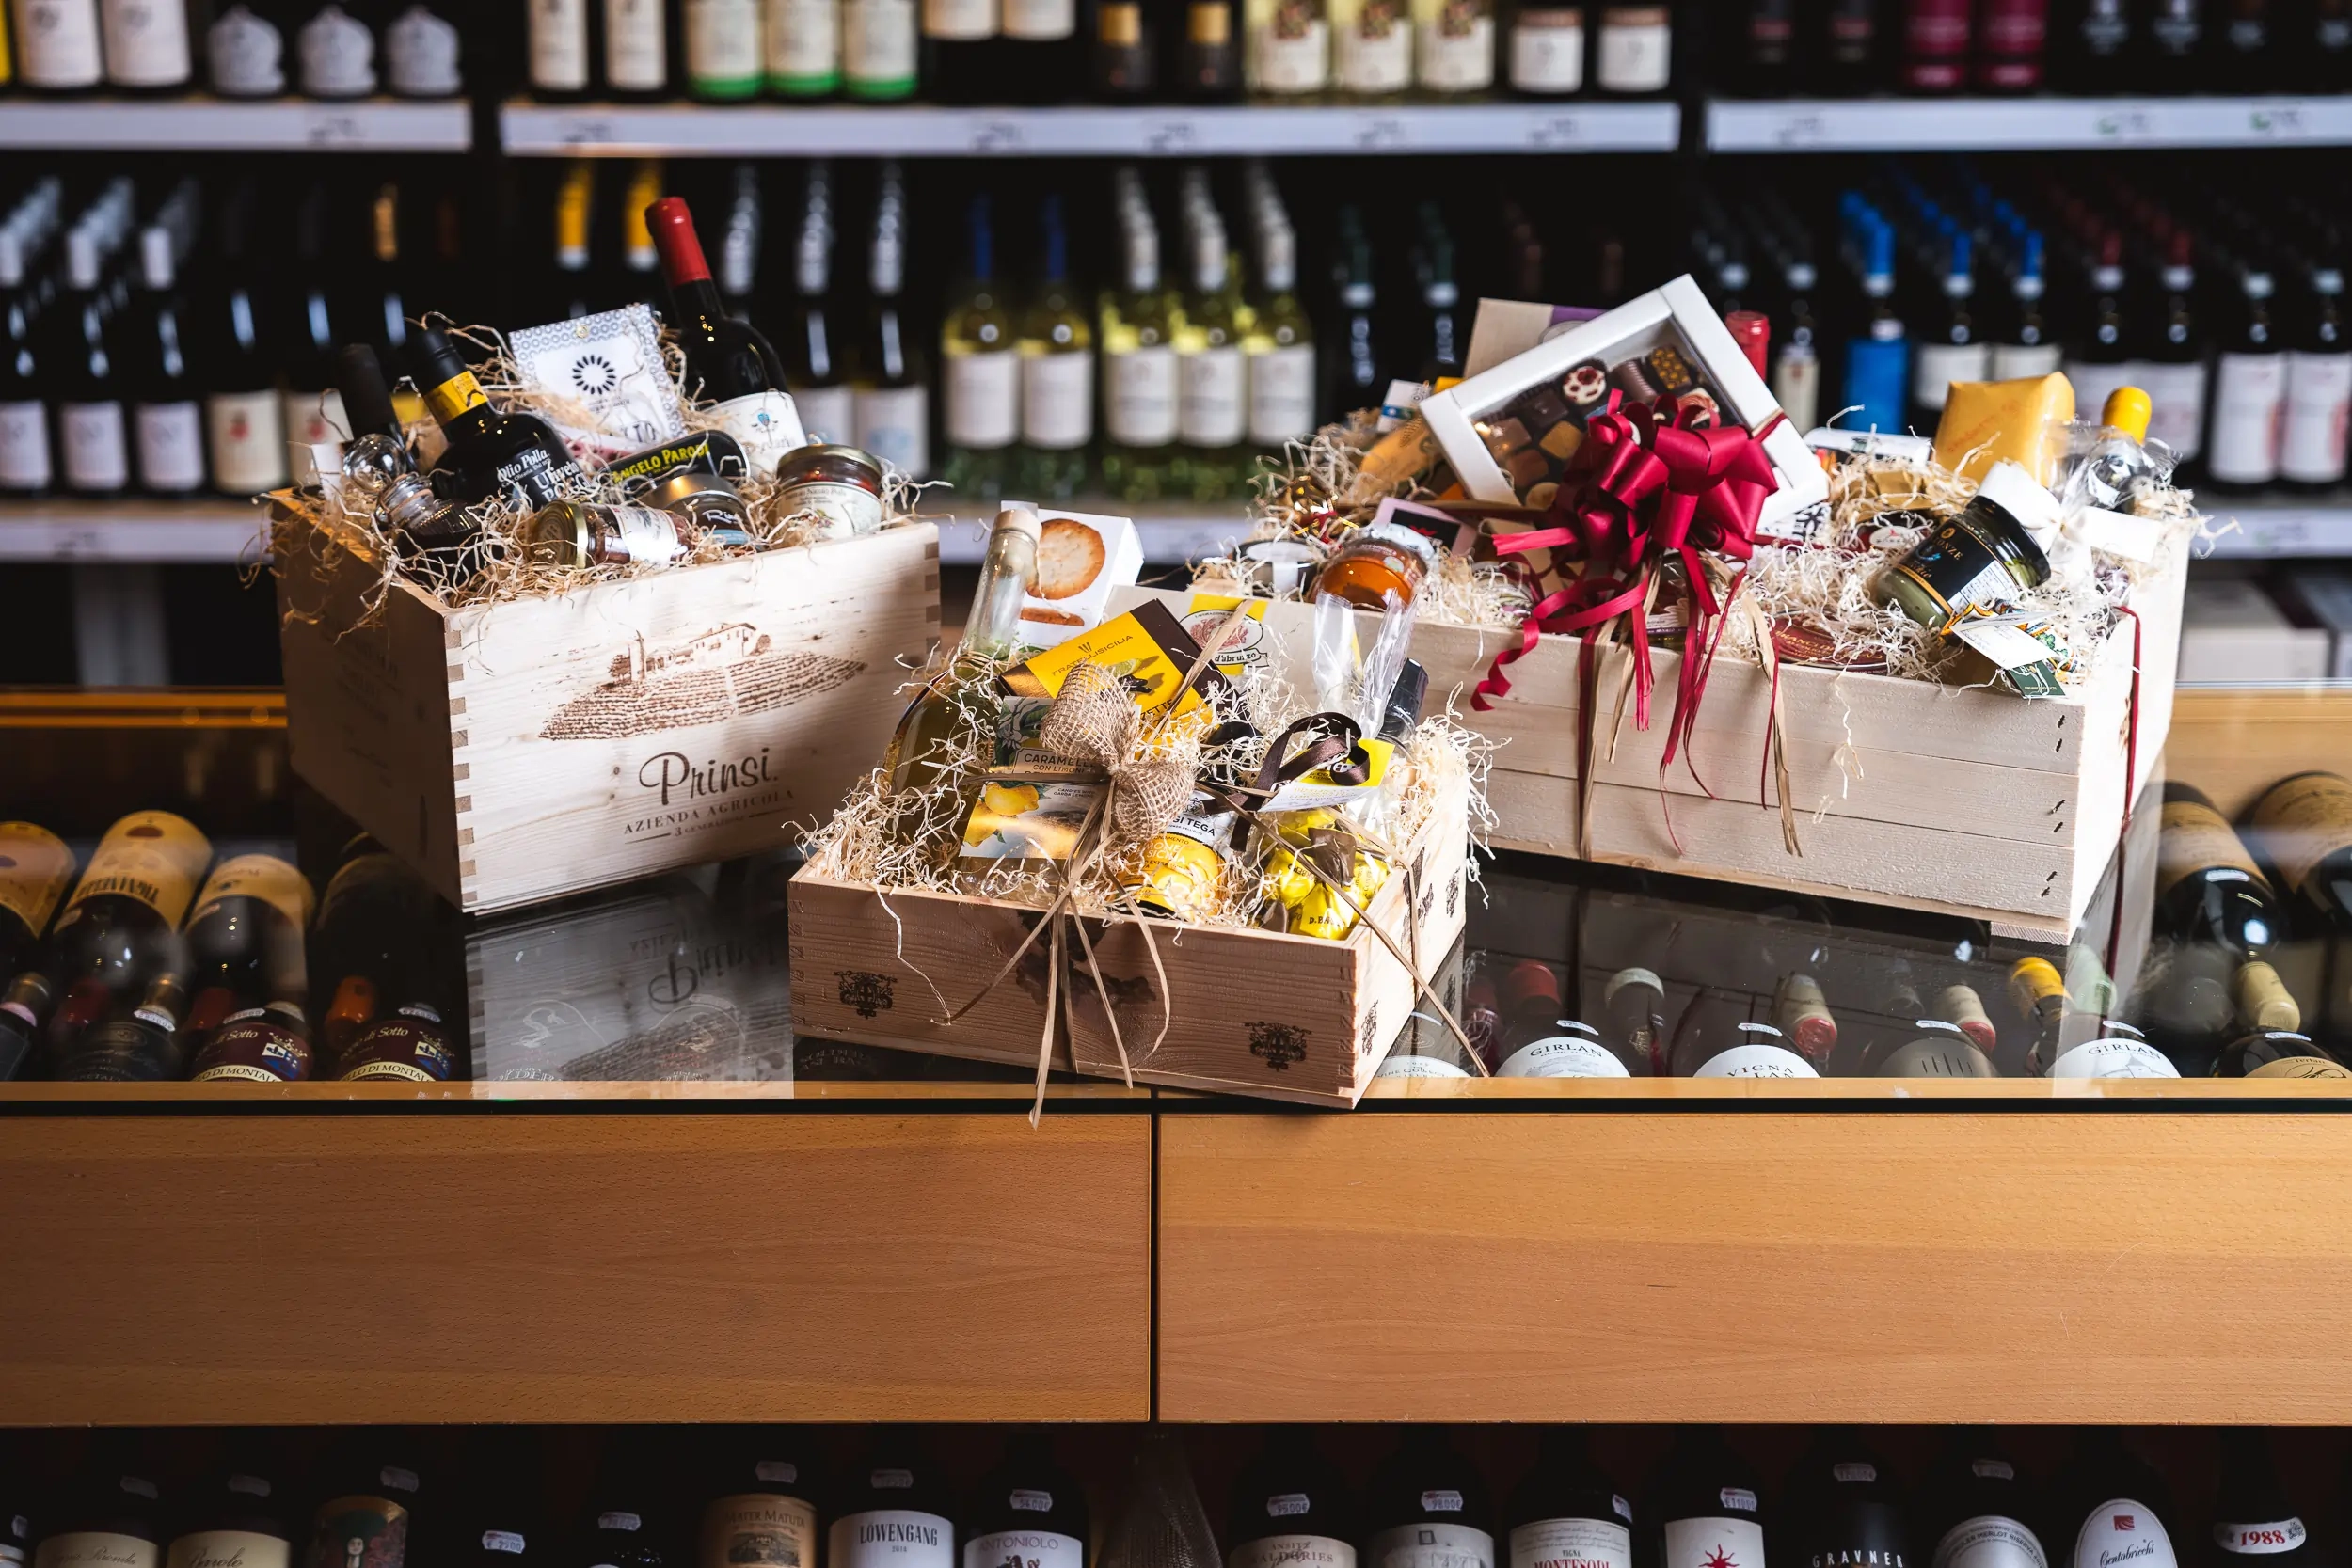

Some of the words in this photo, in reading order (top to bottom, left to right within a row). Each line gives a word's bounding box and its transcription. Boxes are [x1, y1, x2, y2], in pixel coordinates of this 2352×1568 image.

[520, 449, 548, 469] Polla
[612, 455, 660, 485] ANGELO
[624, 809, 700, 835] AZIENDA
[707, 789, 796, 816] AGRICOLA
[675, 826, 683, 837] 3
[1187, 817, 1216, 837] TEGA
[227, 1029, 259, 1040] Sotto
[377, 1026, 410, 1037] Sotto
[1530, 1043, 1602, 1058] GIRLAN
[2088, 1043, 2162, 1060] GIRLAN
[1726, 1064, 1795, 1078] VIGNA
[764, 1509, 805, 1528] MATUTA
[859, 1522, 938, 1547] LÖWENGANG
[2240, 1529, 2286, 1547] 1988
[978, 1537, 1059, 1552] ANTONIOLO
[1812, 1550, 1904, 1568] GRAVNER
